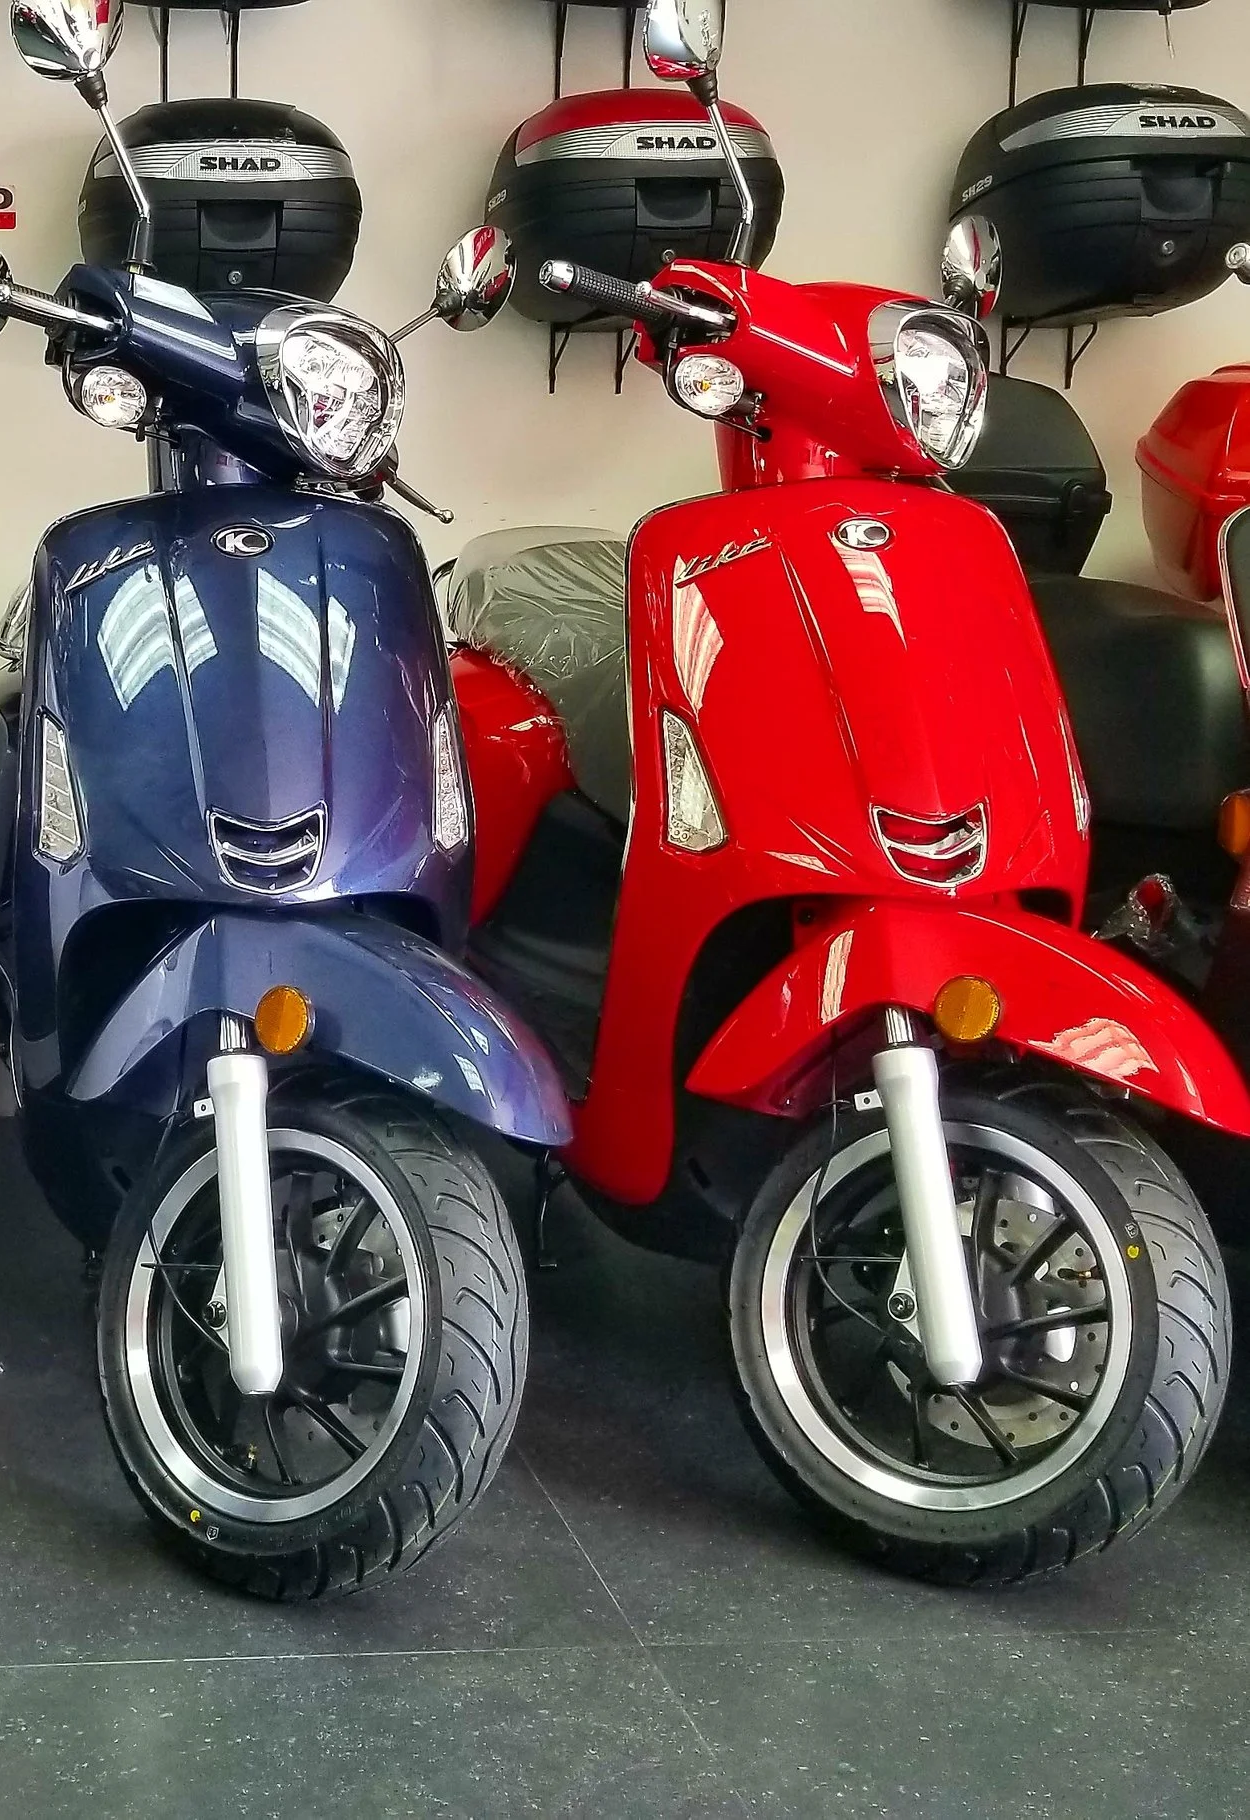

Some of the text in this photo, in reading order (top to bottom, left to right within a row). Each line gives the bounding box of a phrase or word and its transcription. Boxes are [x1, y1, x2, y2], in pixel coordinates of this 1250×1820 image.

[1139, 115, 1216, 129] SHAD
[637, 136, 717, 150] SHAD
[200, 157, 281, 172] SHAD
[962, 175, 993, 202] SH29
